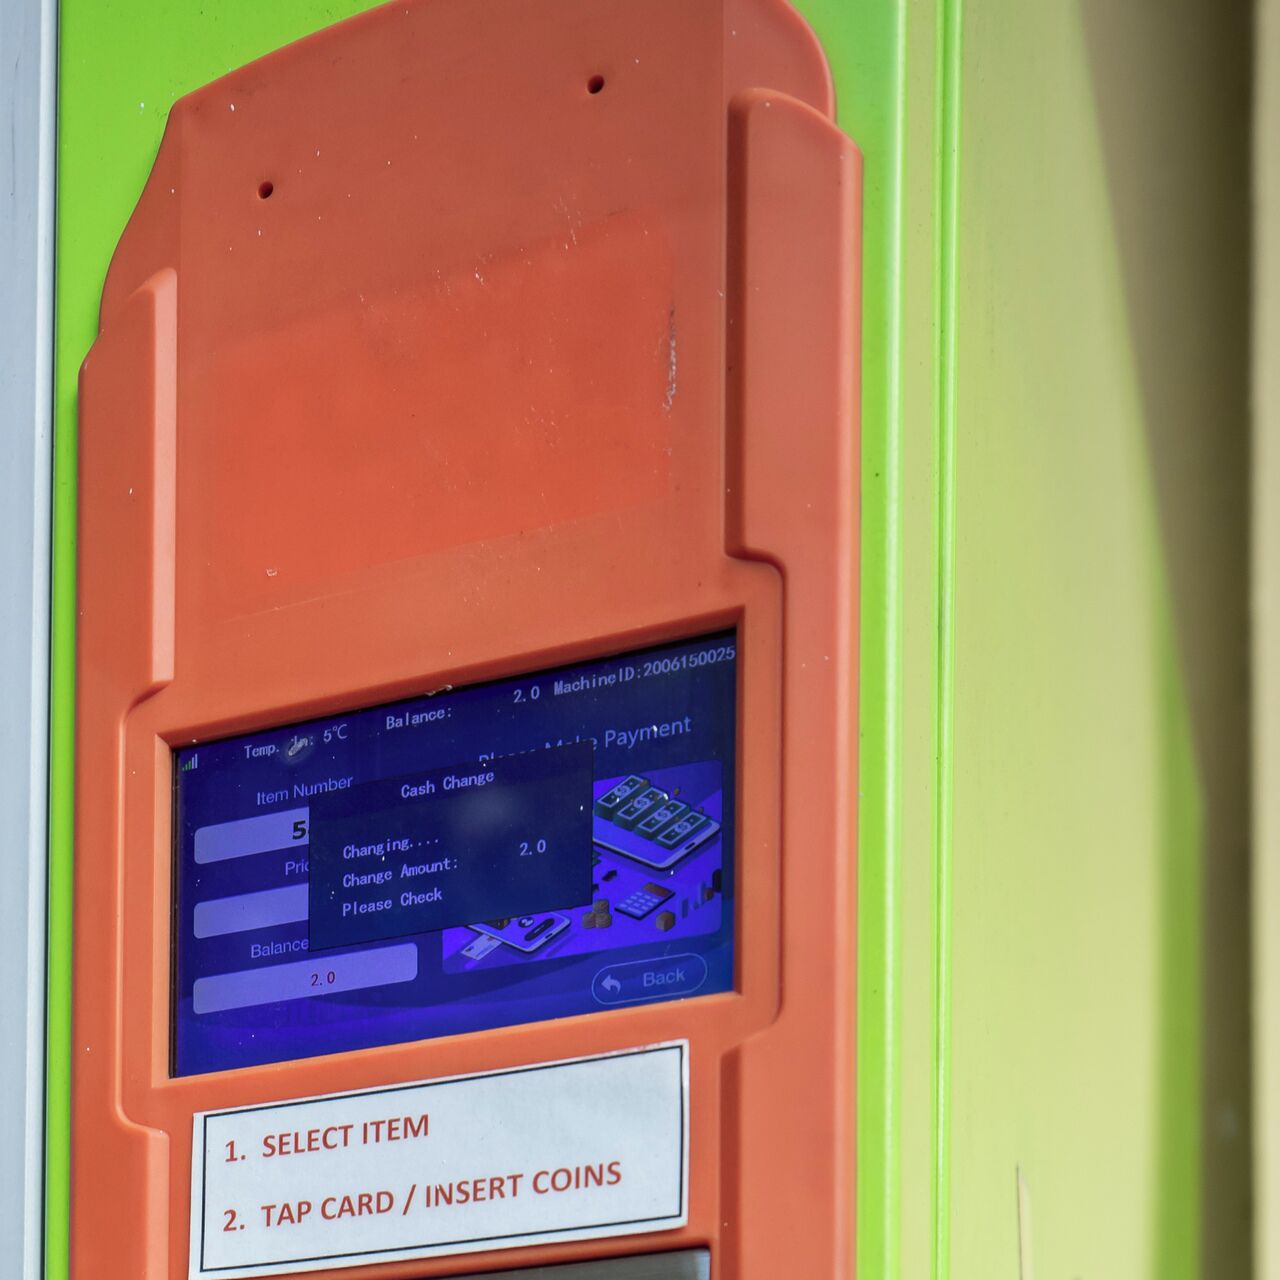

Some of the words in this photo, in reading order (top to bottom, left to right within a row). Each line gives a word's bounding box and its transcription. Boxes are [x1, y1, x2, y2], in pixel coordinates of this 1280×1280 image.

[386, 707, 452, 730] Balance:
[513, 686, 540, 703] 2.0
[605, 716, 691, 750] Payment
[244, 744, 280, 759] Temp.
[257, 788, 289, 806] Item
[293, 776, 354, 798] Number
[401, 780, 435, 798] Cash
[443, 770, 494, 791] Change
[292, 820, 309, 840] 5
[519, 840, 546, 856] 2.0
[343, 869, 392, 888] Change
[400, 858, 458, 878] Amount:
[343, 899, 392, 916] Please
[401, 887, 442, 906] Check
[250, 938, 309, 958] Balance
[311, 971, 335, 986] 2.0
[643, 968, 685, 987] Back
[224, 1140, 247, 1163] 1.
[262, 1124, 354, 1158] SELECT
[362, 1113, 430, 1144] ITEM
[223, 1209, 245, 1233] 2.
[261, 1202, 312, 1228] TAP
[321, 1190, 394, 1220] CARD
[402, 1184, 417, 1216] /
[426, 1174, 524, 1208] INSERT
[533, 1161, 622, 1195] COINS
